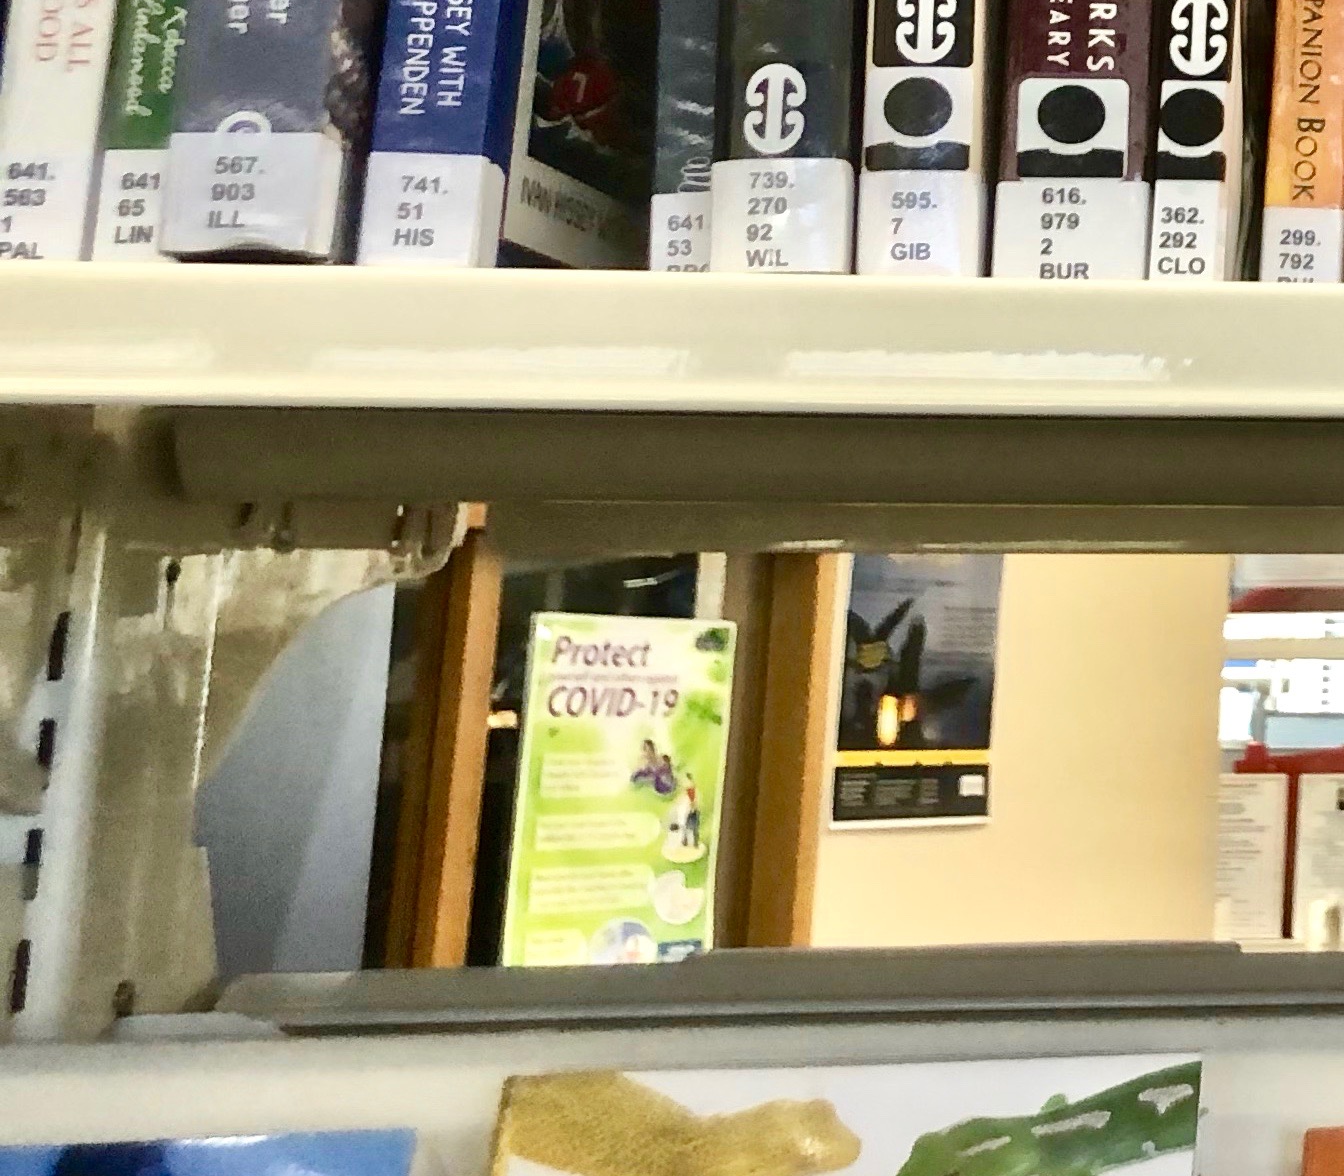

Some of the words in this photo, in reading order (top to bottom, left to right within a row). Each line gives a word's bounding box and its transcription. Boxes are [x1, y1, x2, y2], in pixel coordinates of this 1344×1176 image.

[436, 46, 467, 106] WITH
[1294, 117, 1326, 200] BOOK
[402, 175, 448, 195] 741.
[1041, 187, 1086, 206] 616.
[398, 201, 423, 220] 51
[1160, 208, 1205, 225] 362.
[1040, 211, 1080, 230] 979
[394, 227, 435, 247] HIS
[1040, 237, 1052, 255] 2
[1158, 231, 1198, 249] 292
[1039, 261, 1089, 281] BUR
[1157, 256, 1205, 275] CLO
[550, 635, 652, 667] Protect
[546, 686, 681, 719] COVID-19
